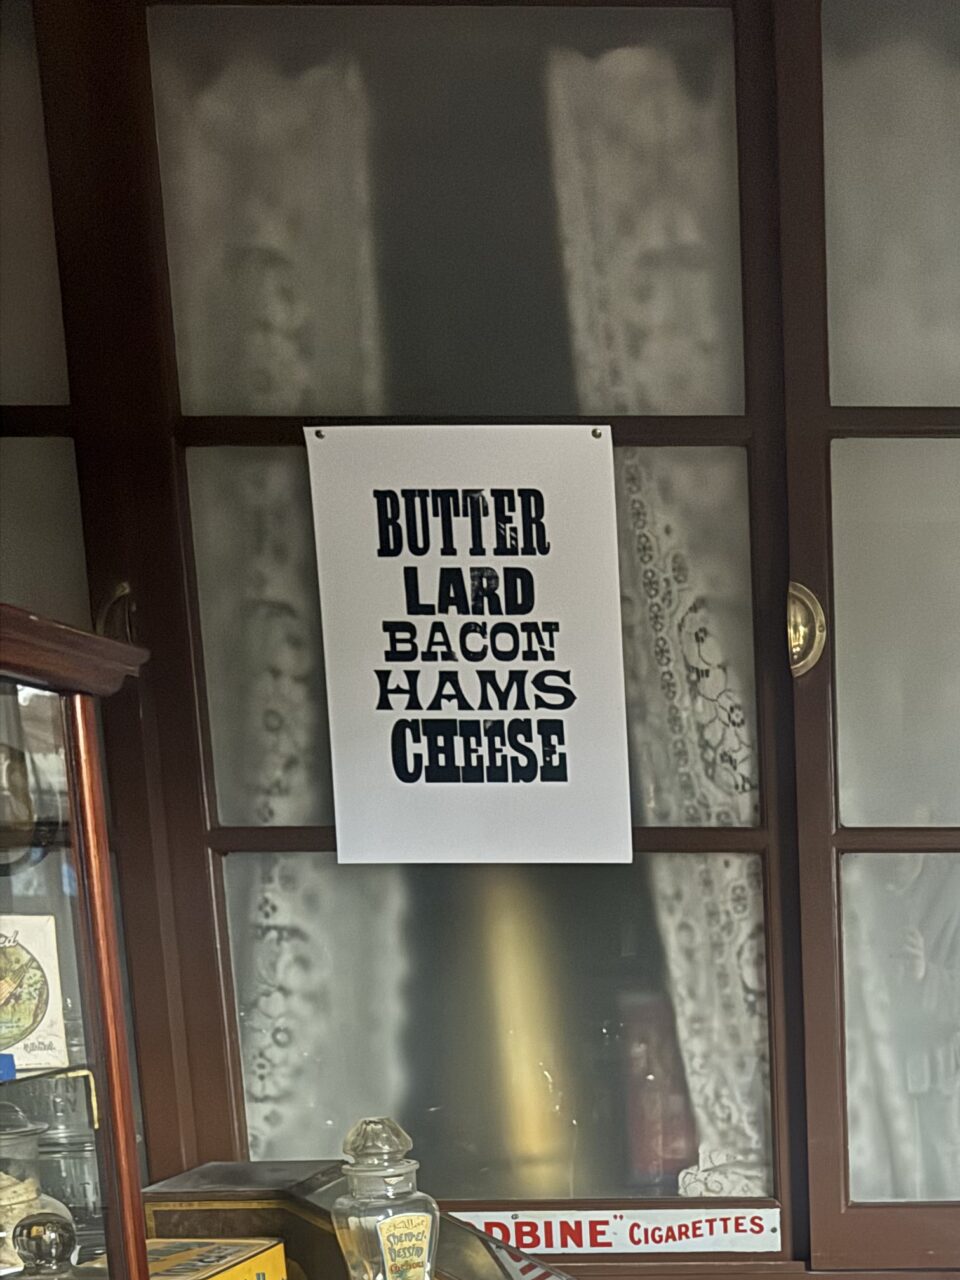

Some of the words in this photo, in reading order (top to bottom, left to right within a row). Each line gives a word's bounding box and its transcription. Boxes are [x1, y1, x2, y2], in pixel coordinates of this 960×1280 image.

[373, 488, 550, 557] BUTTER
[403, 566, 535, 615] LARD
[382, 621, 559, 662] BACON
[373, 669, 577, 710] HAMS
[391, 718, 568, 783] CHEESE
[467, 1214, 624, 1249] DBINE"
[629, 1215, 764, 1246] CIGARETTES
